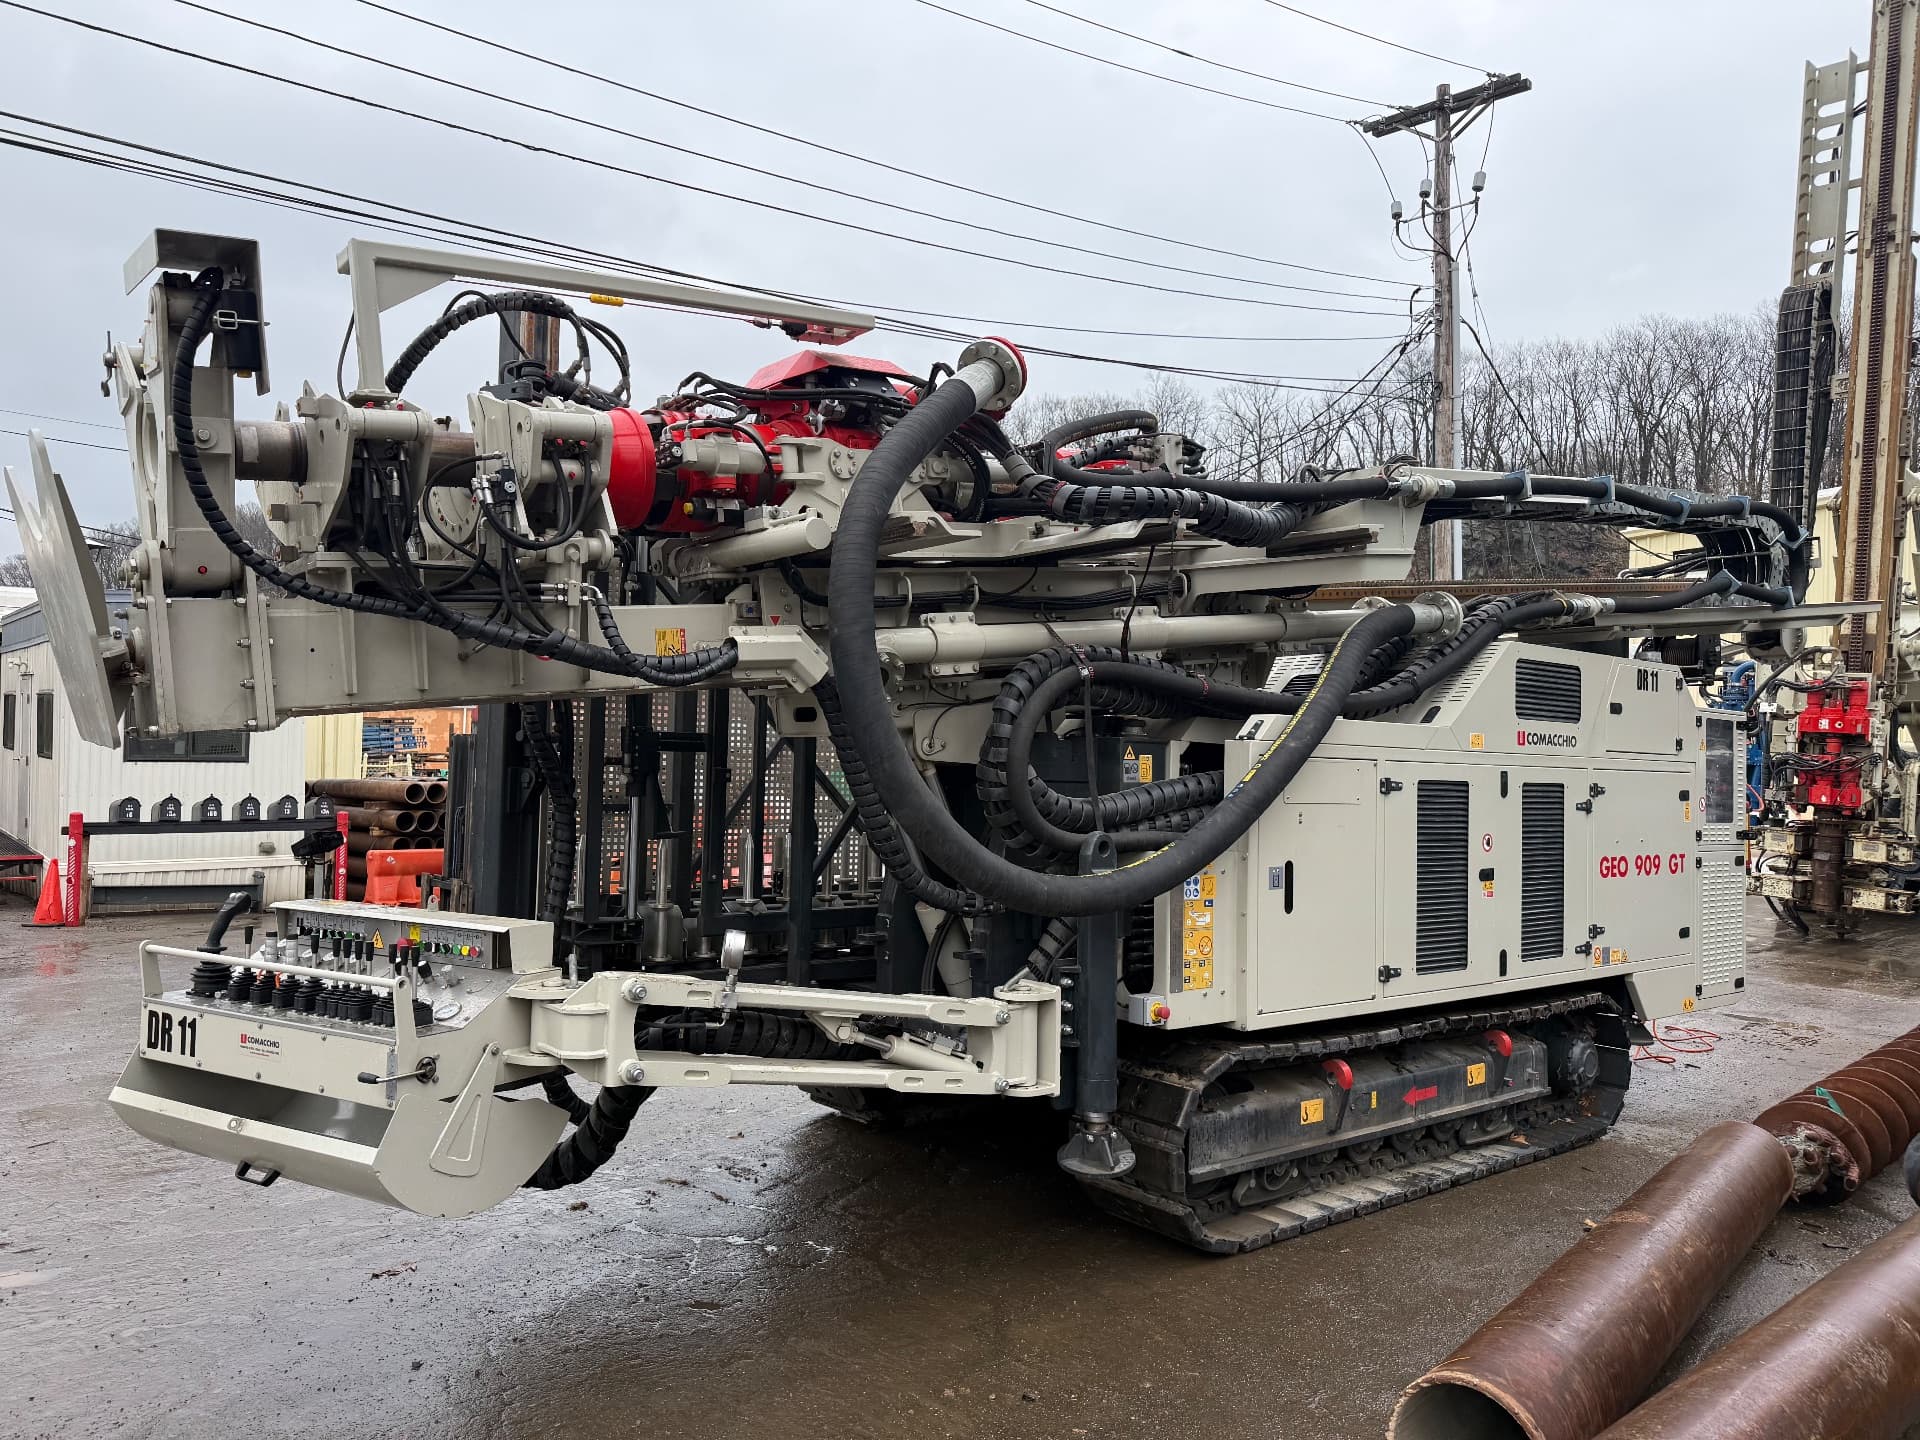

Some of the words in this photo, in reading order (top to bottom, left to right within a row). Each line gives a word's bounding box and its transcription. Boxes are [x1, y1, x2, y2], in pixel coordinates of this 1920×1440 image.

[1637, 669, 1648, 691] DR
[1650, 671, 1659, 693] 11
[1527, 732, 1577, 748] COMACCHIO
[1600, 855, 1629, 878] GEO
[1634, 854, 1661, 876] 909
[1668, 853, 1686, 874] GT
[147, 1009, 173, 1053] DR
[177, 1015, 197, 1058] 11
[247, 1036, 280, 1049] COMACCHIO
